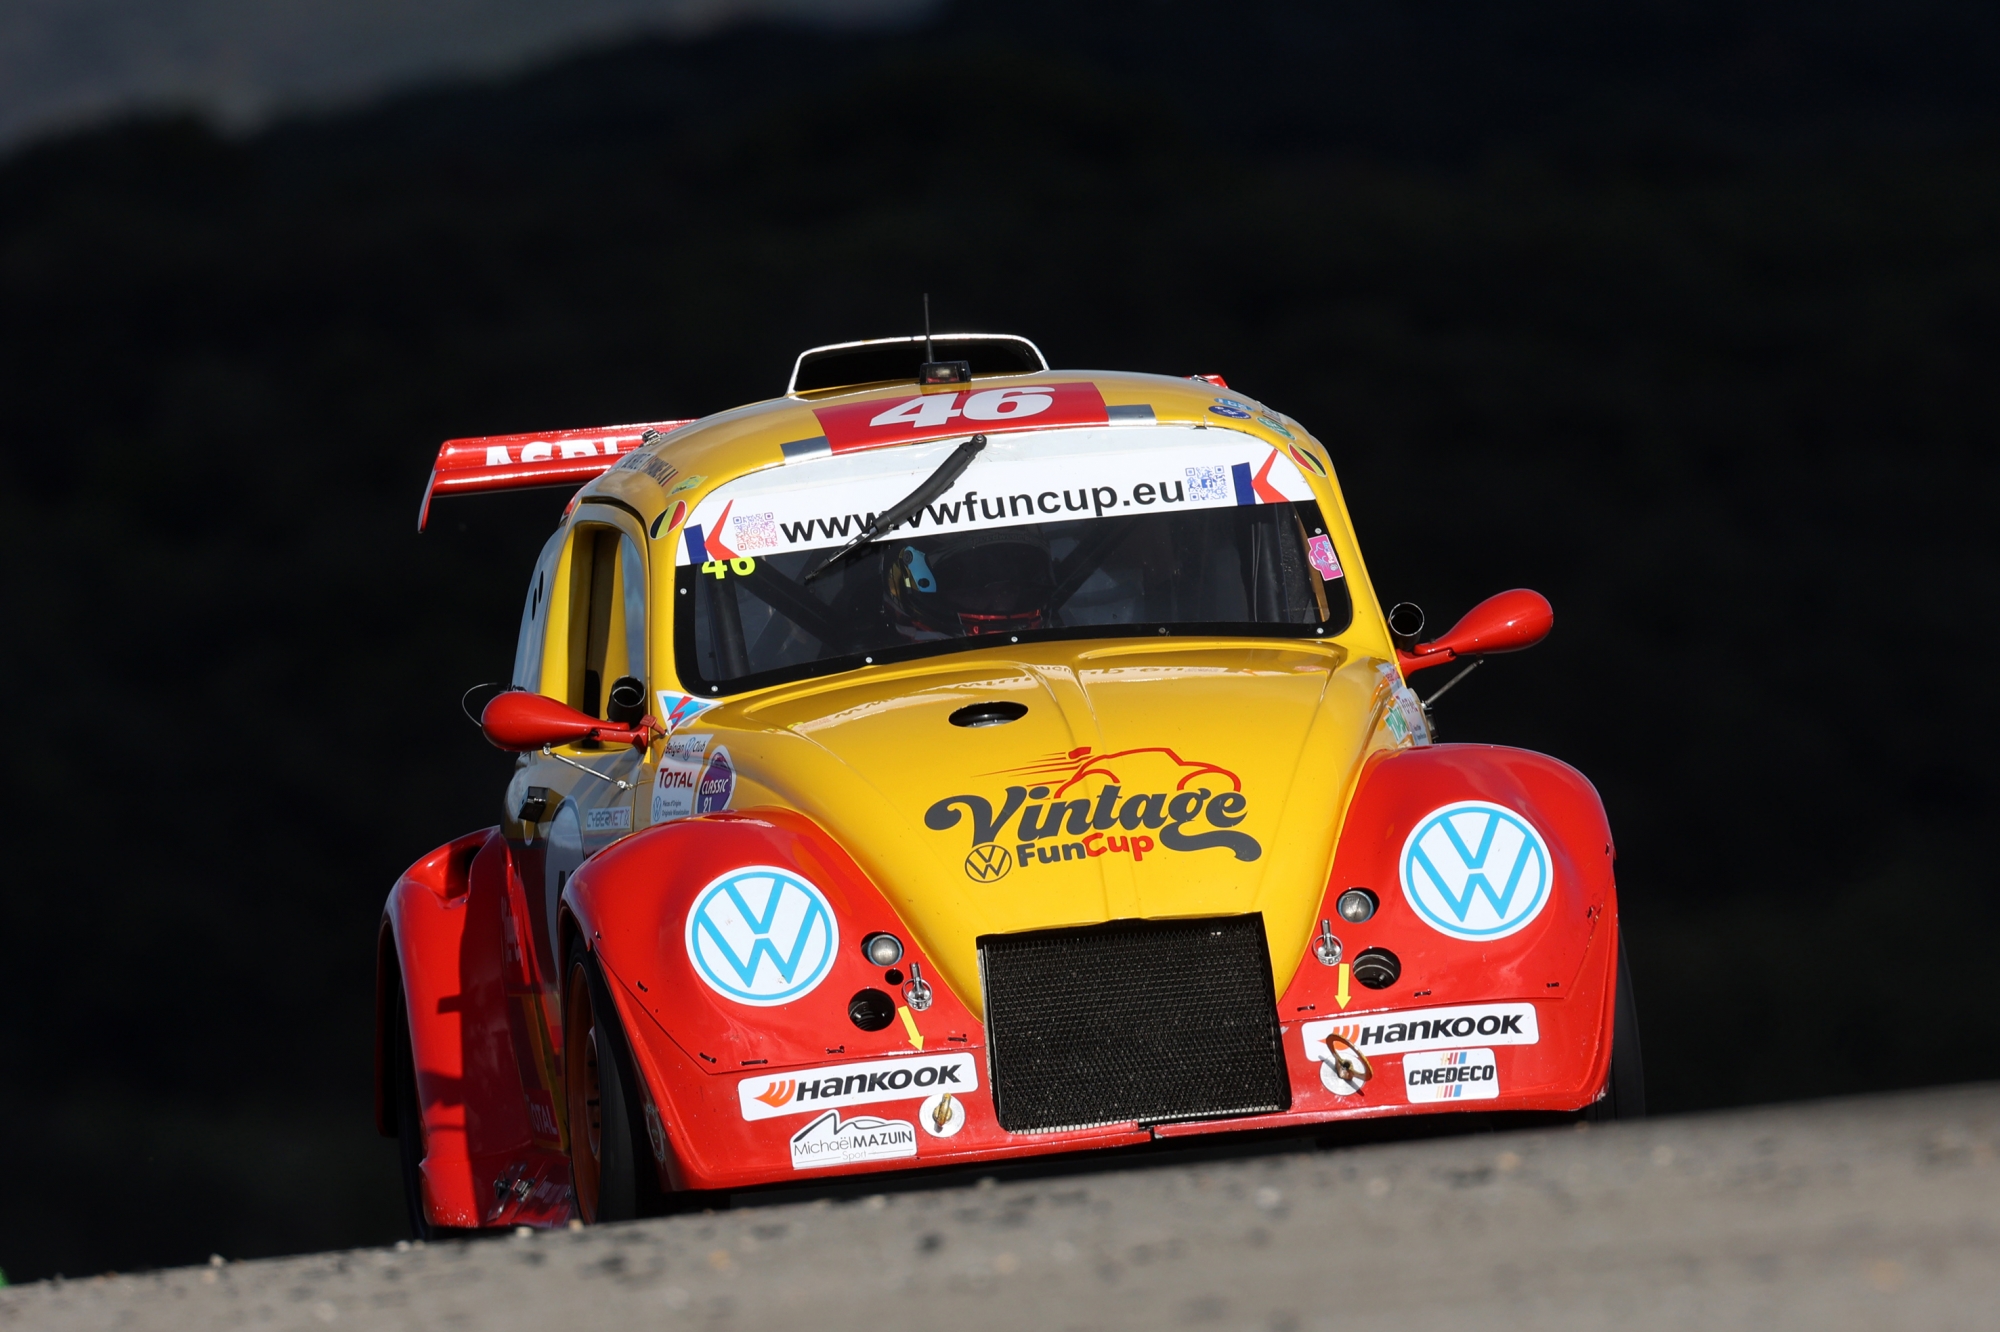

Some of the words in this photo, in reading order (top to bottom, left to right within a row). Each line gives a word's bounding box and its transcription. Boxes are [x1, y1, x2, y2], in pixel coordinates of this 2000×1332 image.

[869, 386, 1056, 428] 46
[702, 556, 756, 580] 46
[693, 740, 706, 753] Club
[702, 779, 728, 795] CLASSIC
[702, 797, 713, 813] 21
[924, 784, 1262, 862] Vintage
[1016, 833, 1154, 867] FunCup
[1408, 1064, 1495, 1086] CREDECO
[842, 1150, 867, 1164] Sport
